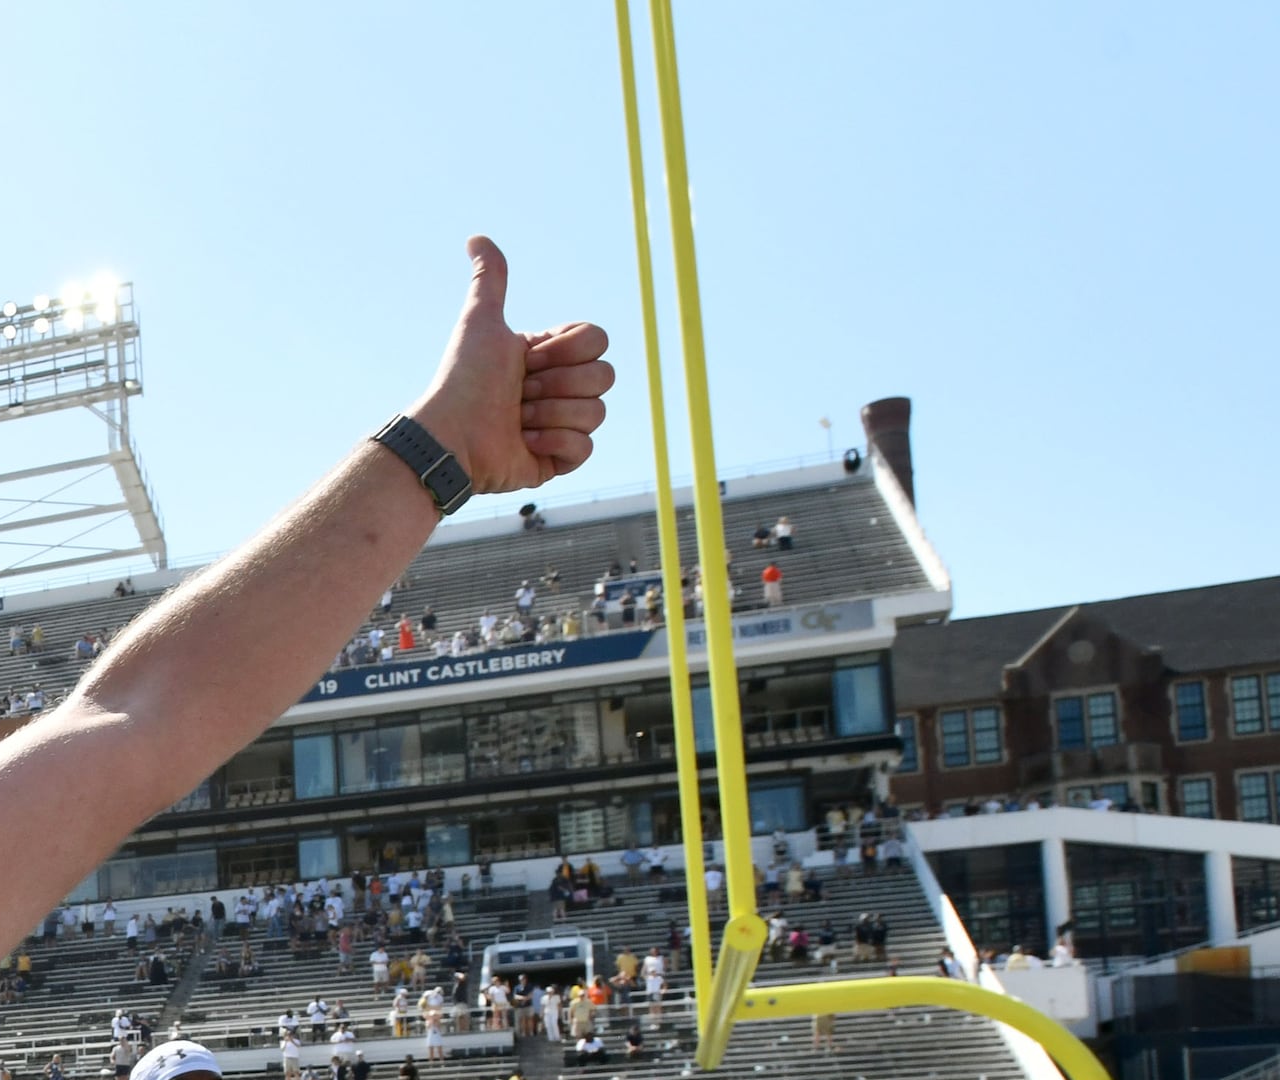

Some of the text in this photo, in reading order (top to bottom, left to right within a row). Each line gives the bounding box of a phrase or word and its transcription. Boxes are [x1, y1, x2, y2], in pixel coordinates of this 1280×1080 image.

[318, 649, 566, 694] 19 CLINT CASTLEBERRY
